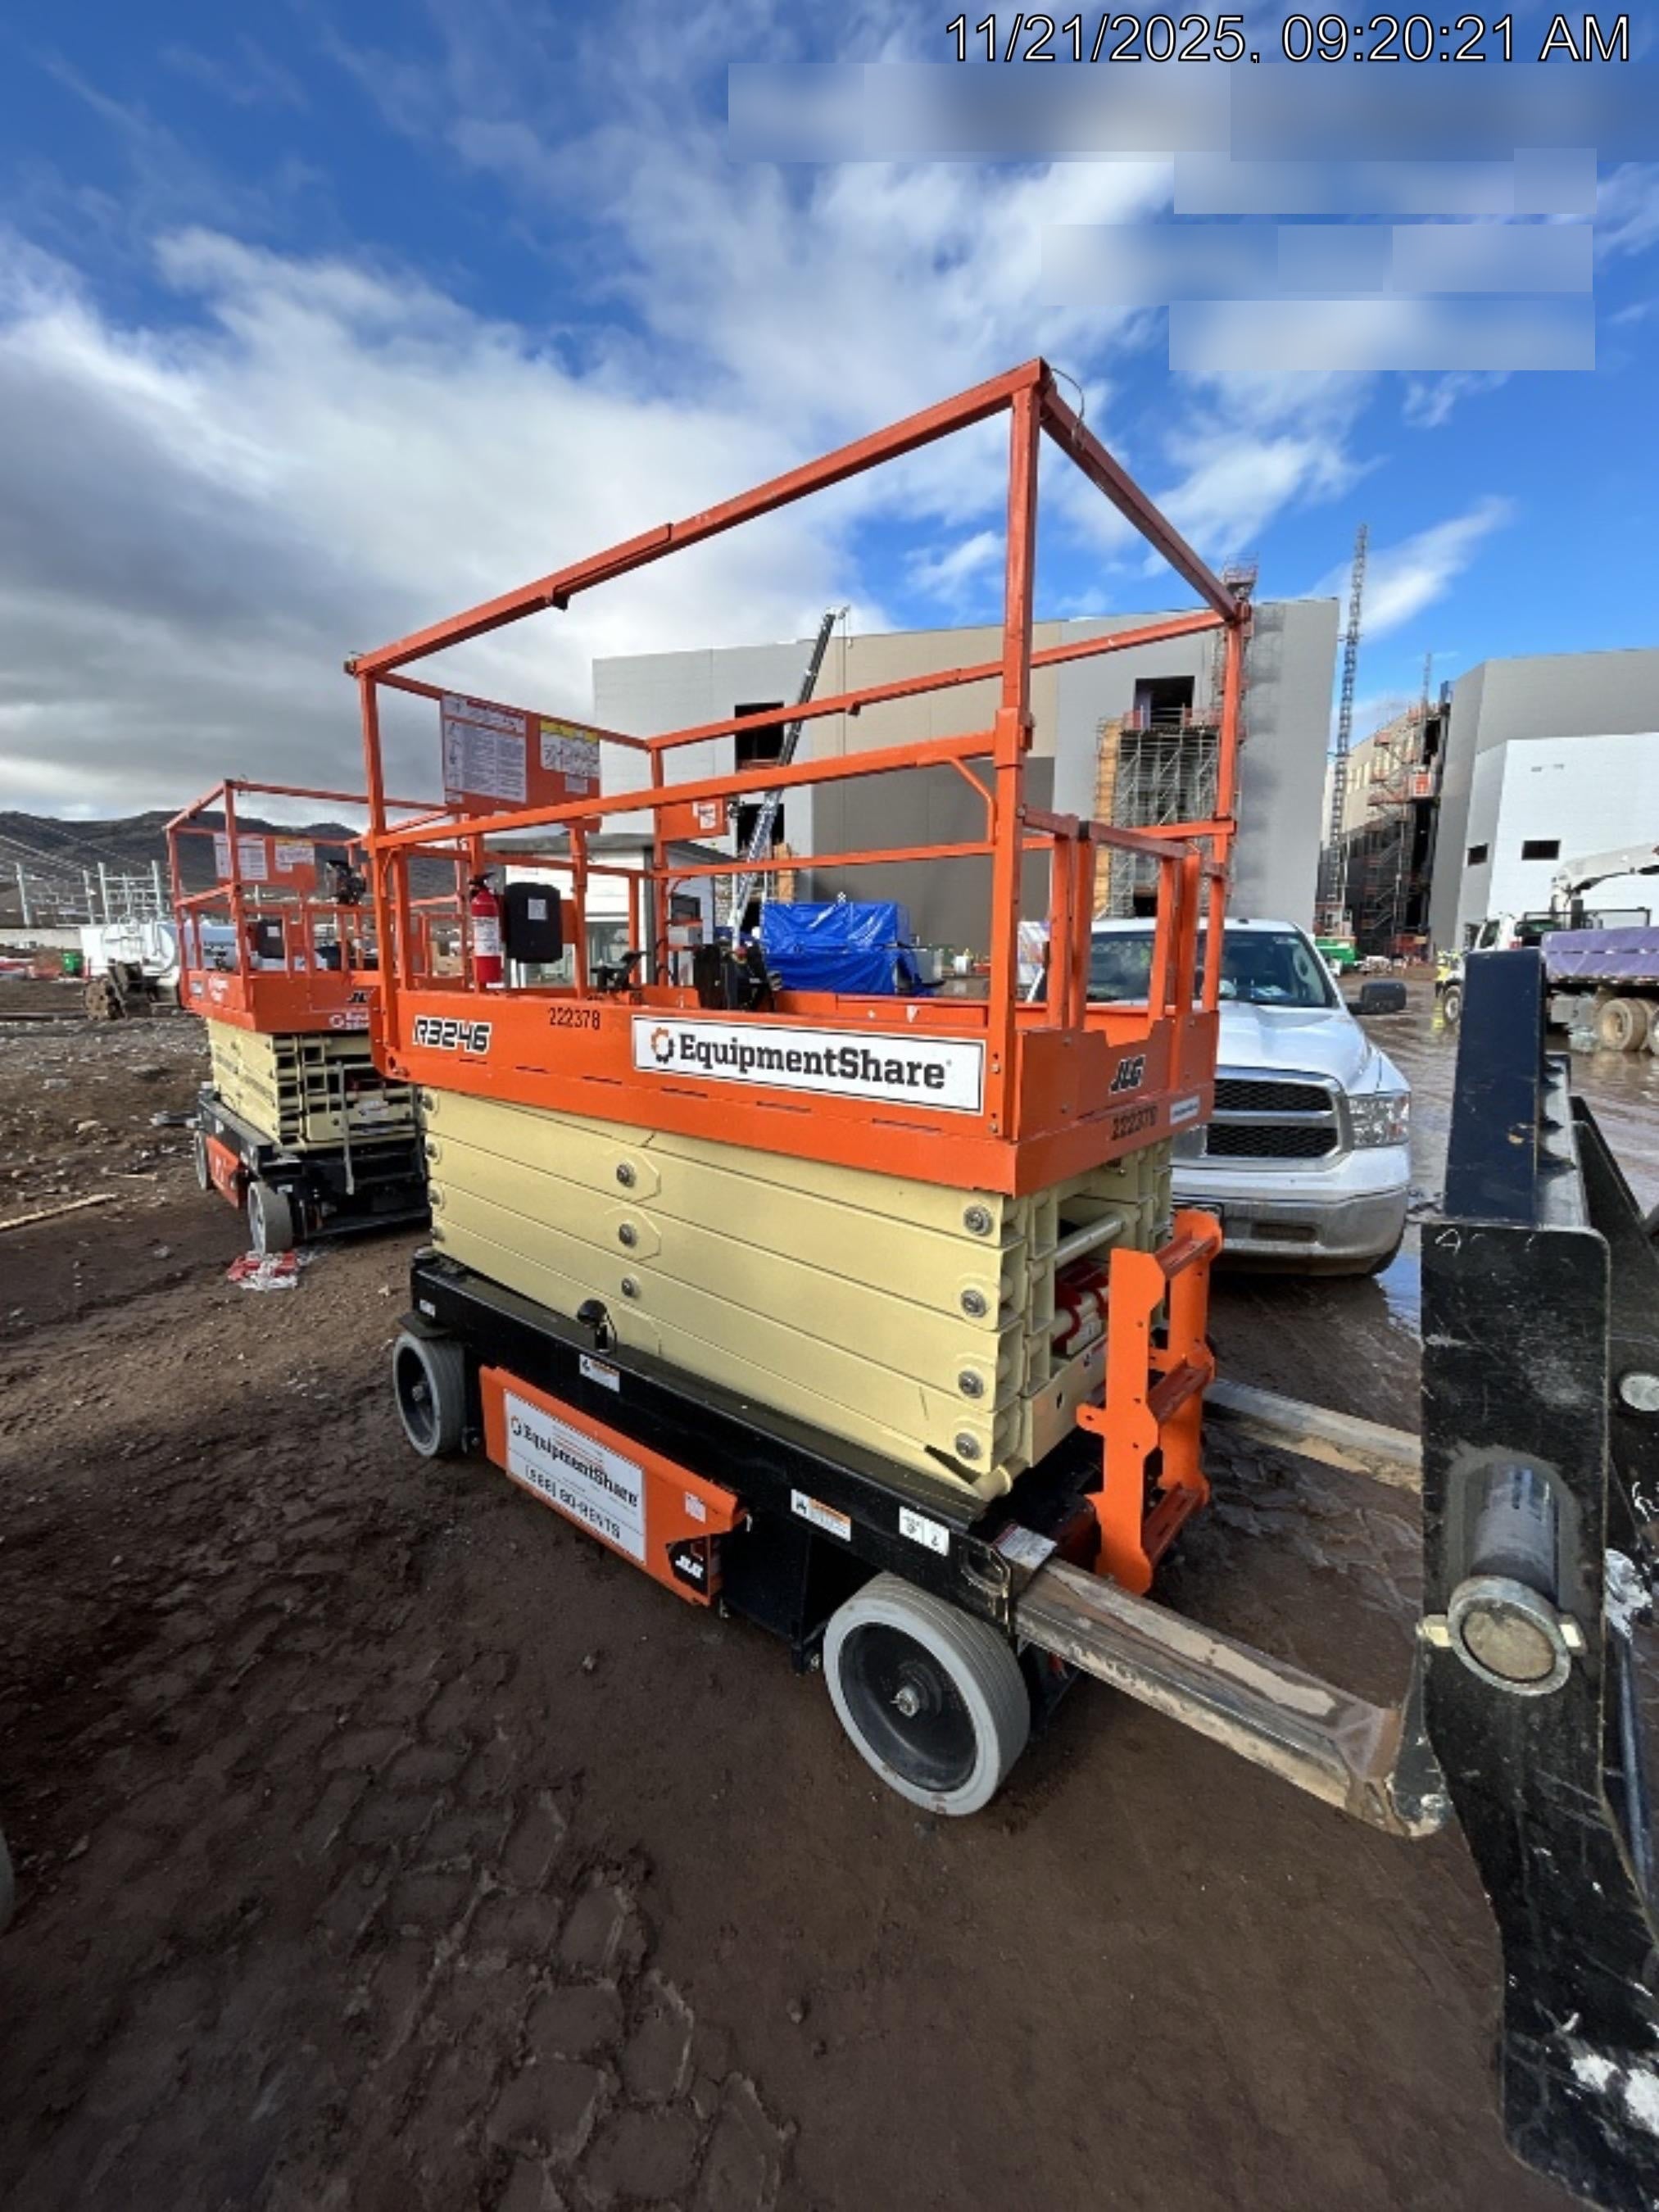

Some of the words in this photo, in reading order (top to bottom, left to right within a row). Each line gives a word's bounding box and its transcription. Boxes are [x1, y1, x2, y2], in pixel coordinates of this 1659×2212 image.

[413, 1015, 492, 1054] R3246
[547, 1007, 601, 1031] 222378
[679, 1032, 946, 1090] EquipmentShare
[1108, 1054, 1146, 1095] JLG
